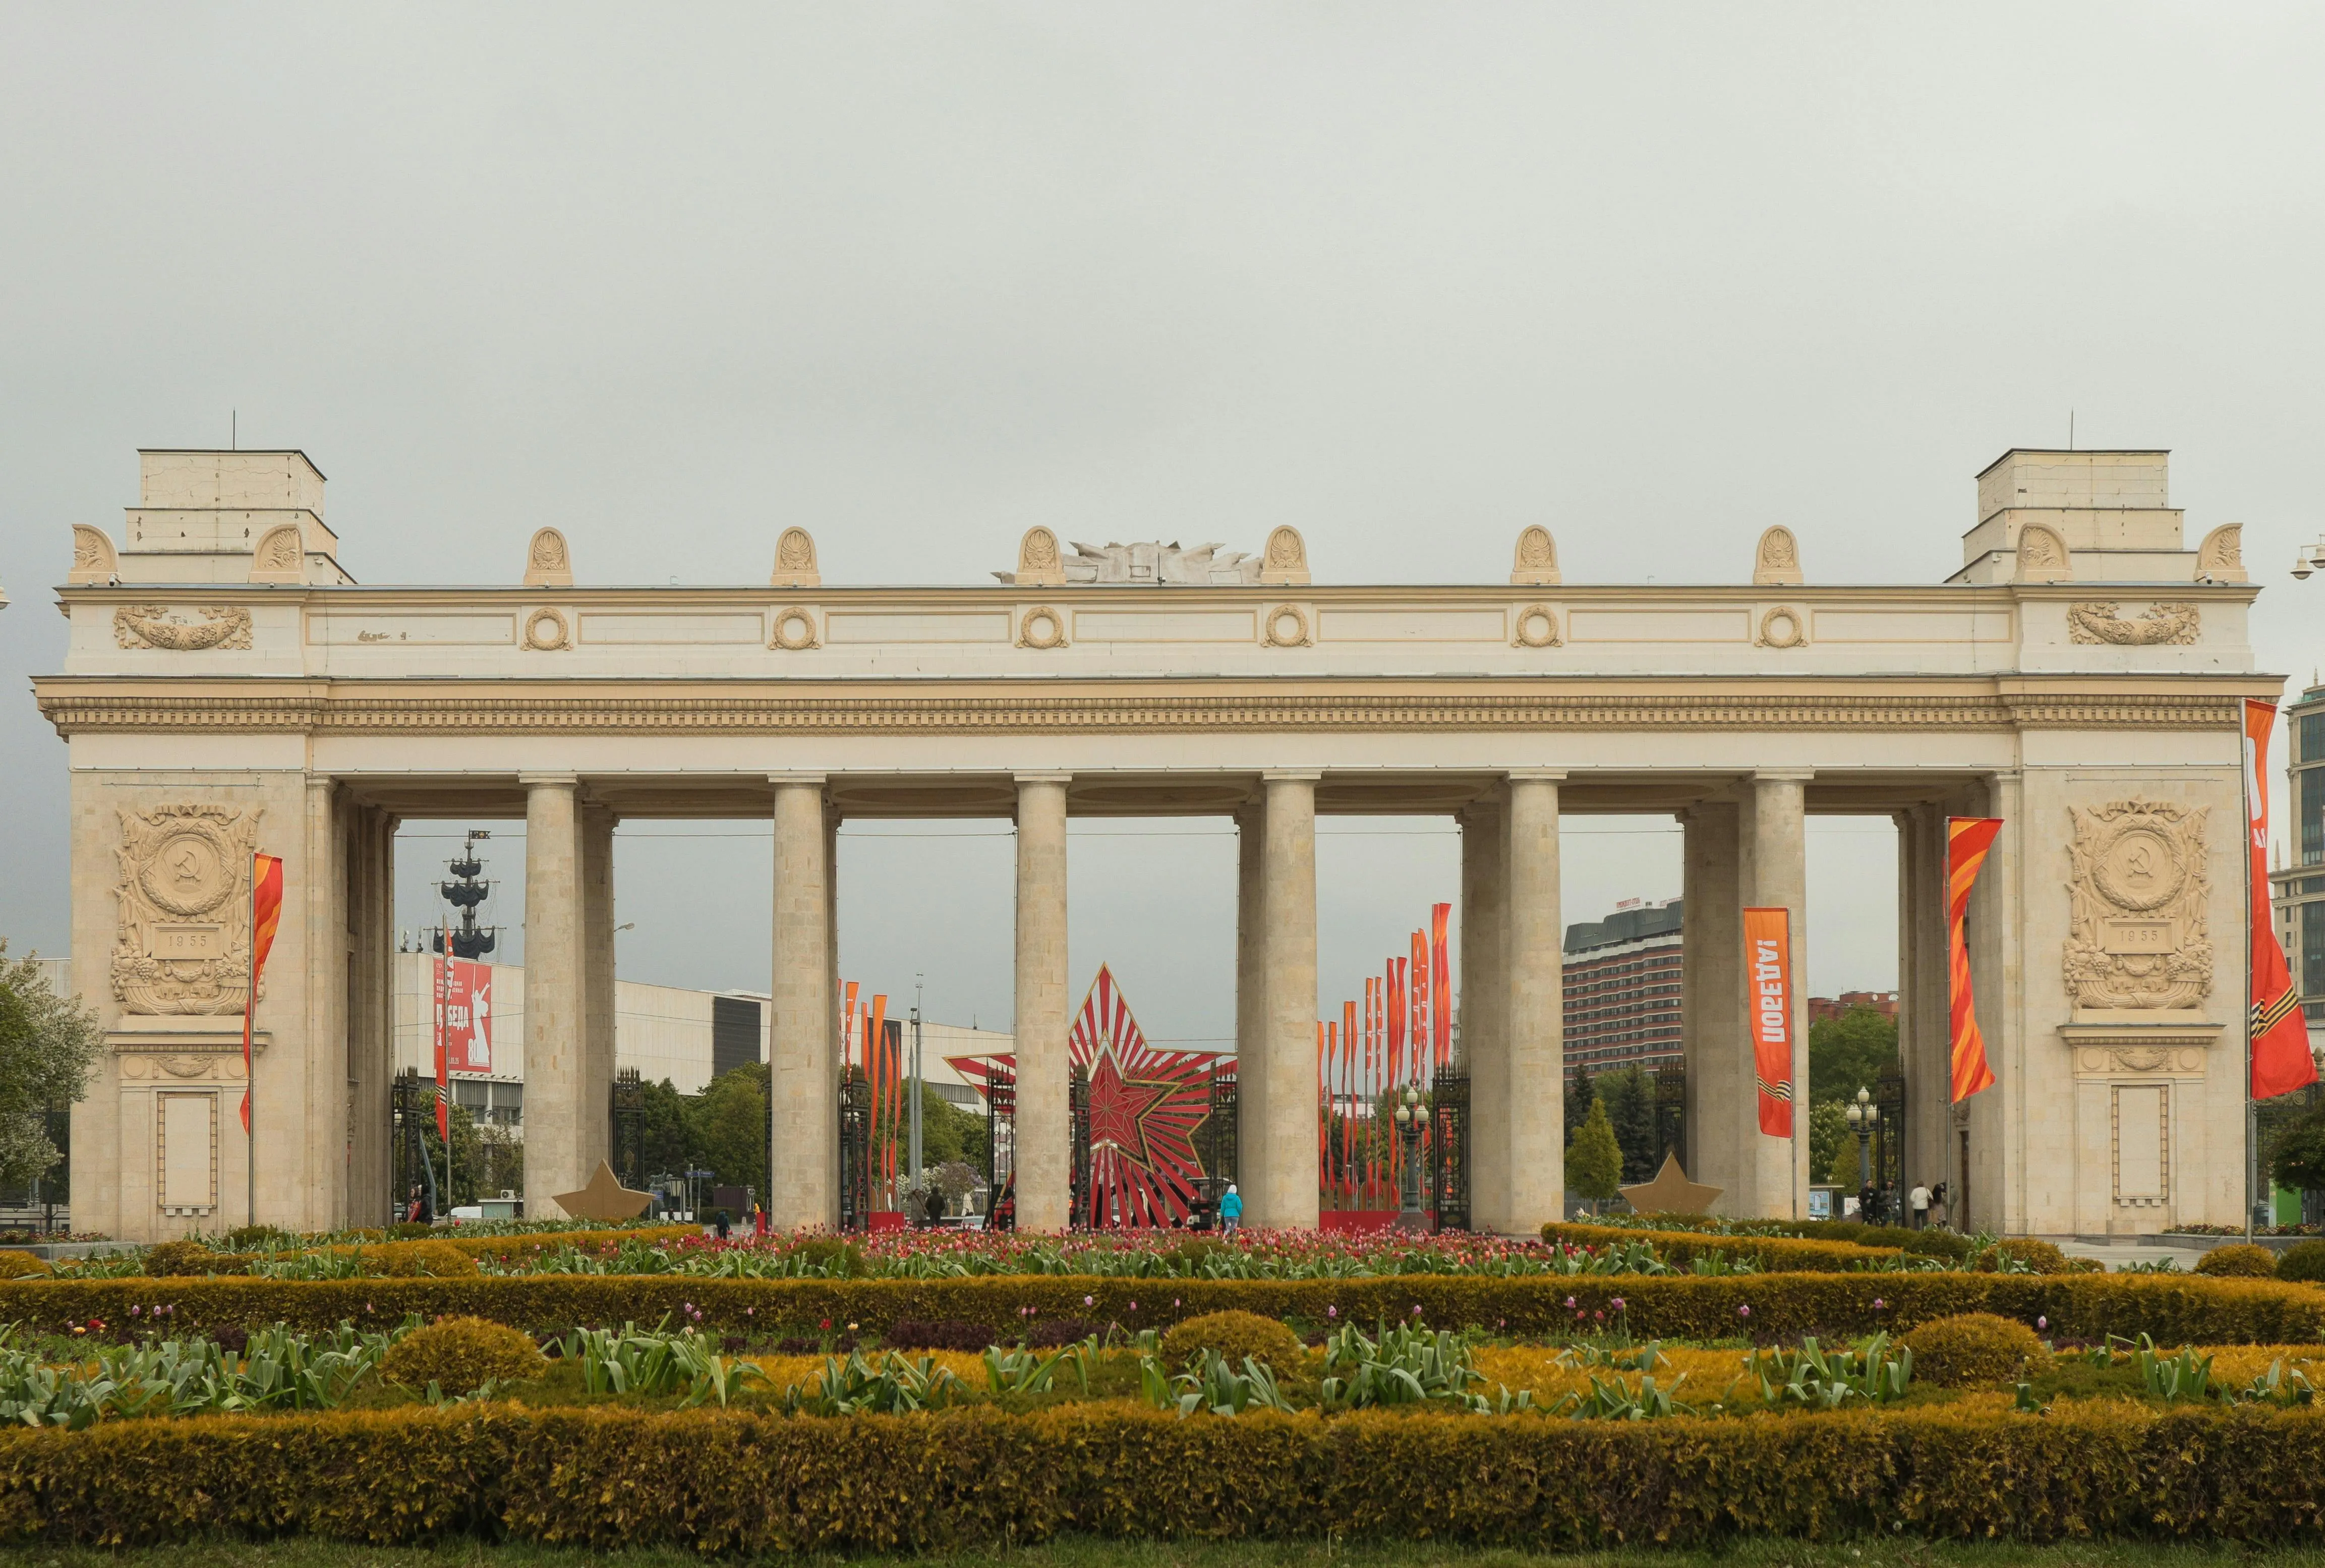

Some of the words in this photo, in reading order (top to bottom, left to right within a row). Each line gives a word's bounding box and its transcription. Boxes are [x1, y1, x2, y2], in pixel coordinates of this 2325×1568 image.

[169, 936, 206, 947] 1955
[2121, 930, 2158, 942] 1955
[436, 1004, 469, 1030] ПБЕДА
